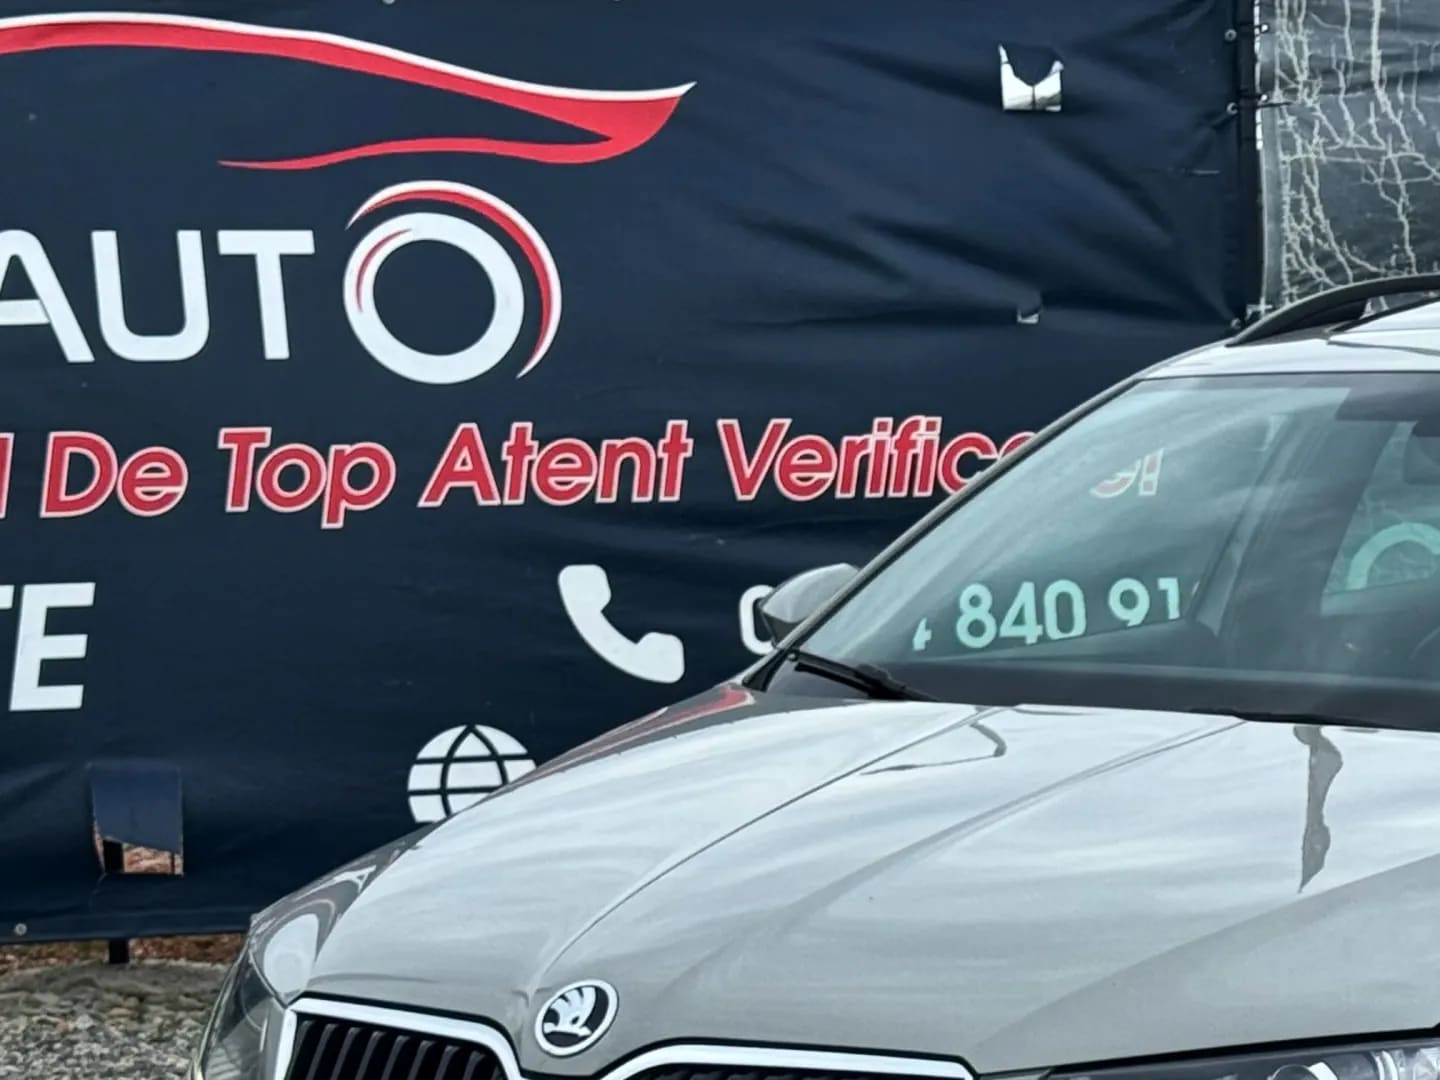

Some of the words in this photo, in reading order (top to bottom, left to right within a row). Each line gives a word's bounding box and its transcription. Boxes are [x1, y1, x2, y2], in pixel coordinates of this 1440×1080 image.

[0, 212, 524, 384] AUTO
[39, 430, 189, 518] De
[218, 426, 397, 529] Top
[416, 418, 695, 508] Atent
[716, 415, 1036, 501] Verific
[955, 579, 1087, 649] 840
[1108, 577, 1182, 627] 91
